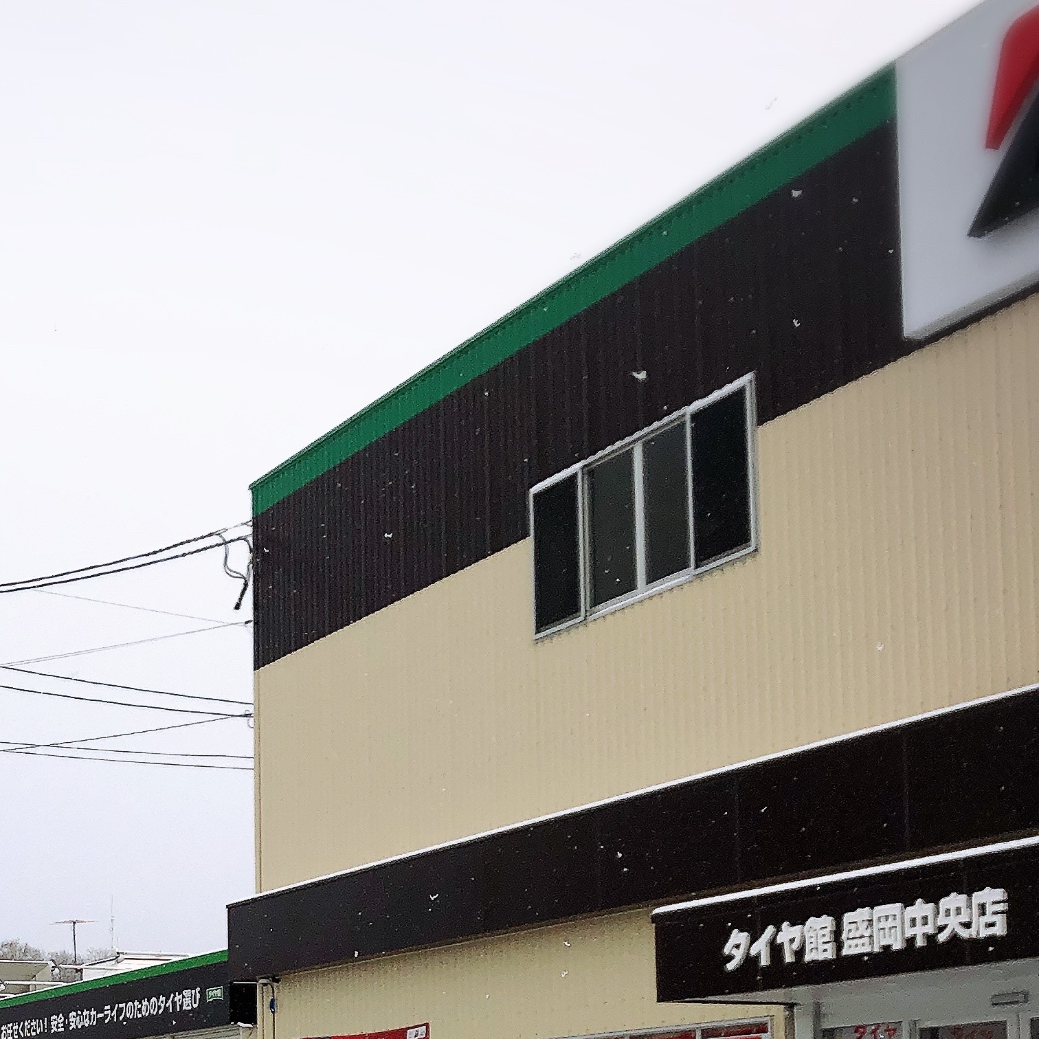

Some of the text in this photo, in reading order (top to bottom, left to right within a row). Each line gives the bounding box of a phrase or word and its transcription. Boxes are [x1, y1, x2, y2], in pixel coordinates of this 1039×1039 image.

[723, 886, 1009, 972] タイヤ館 盛岡中央店
